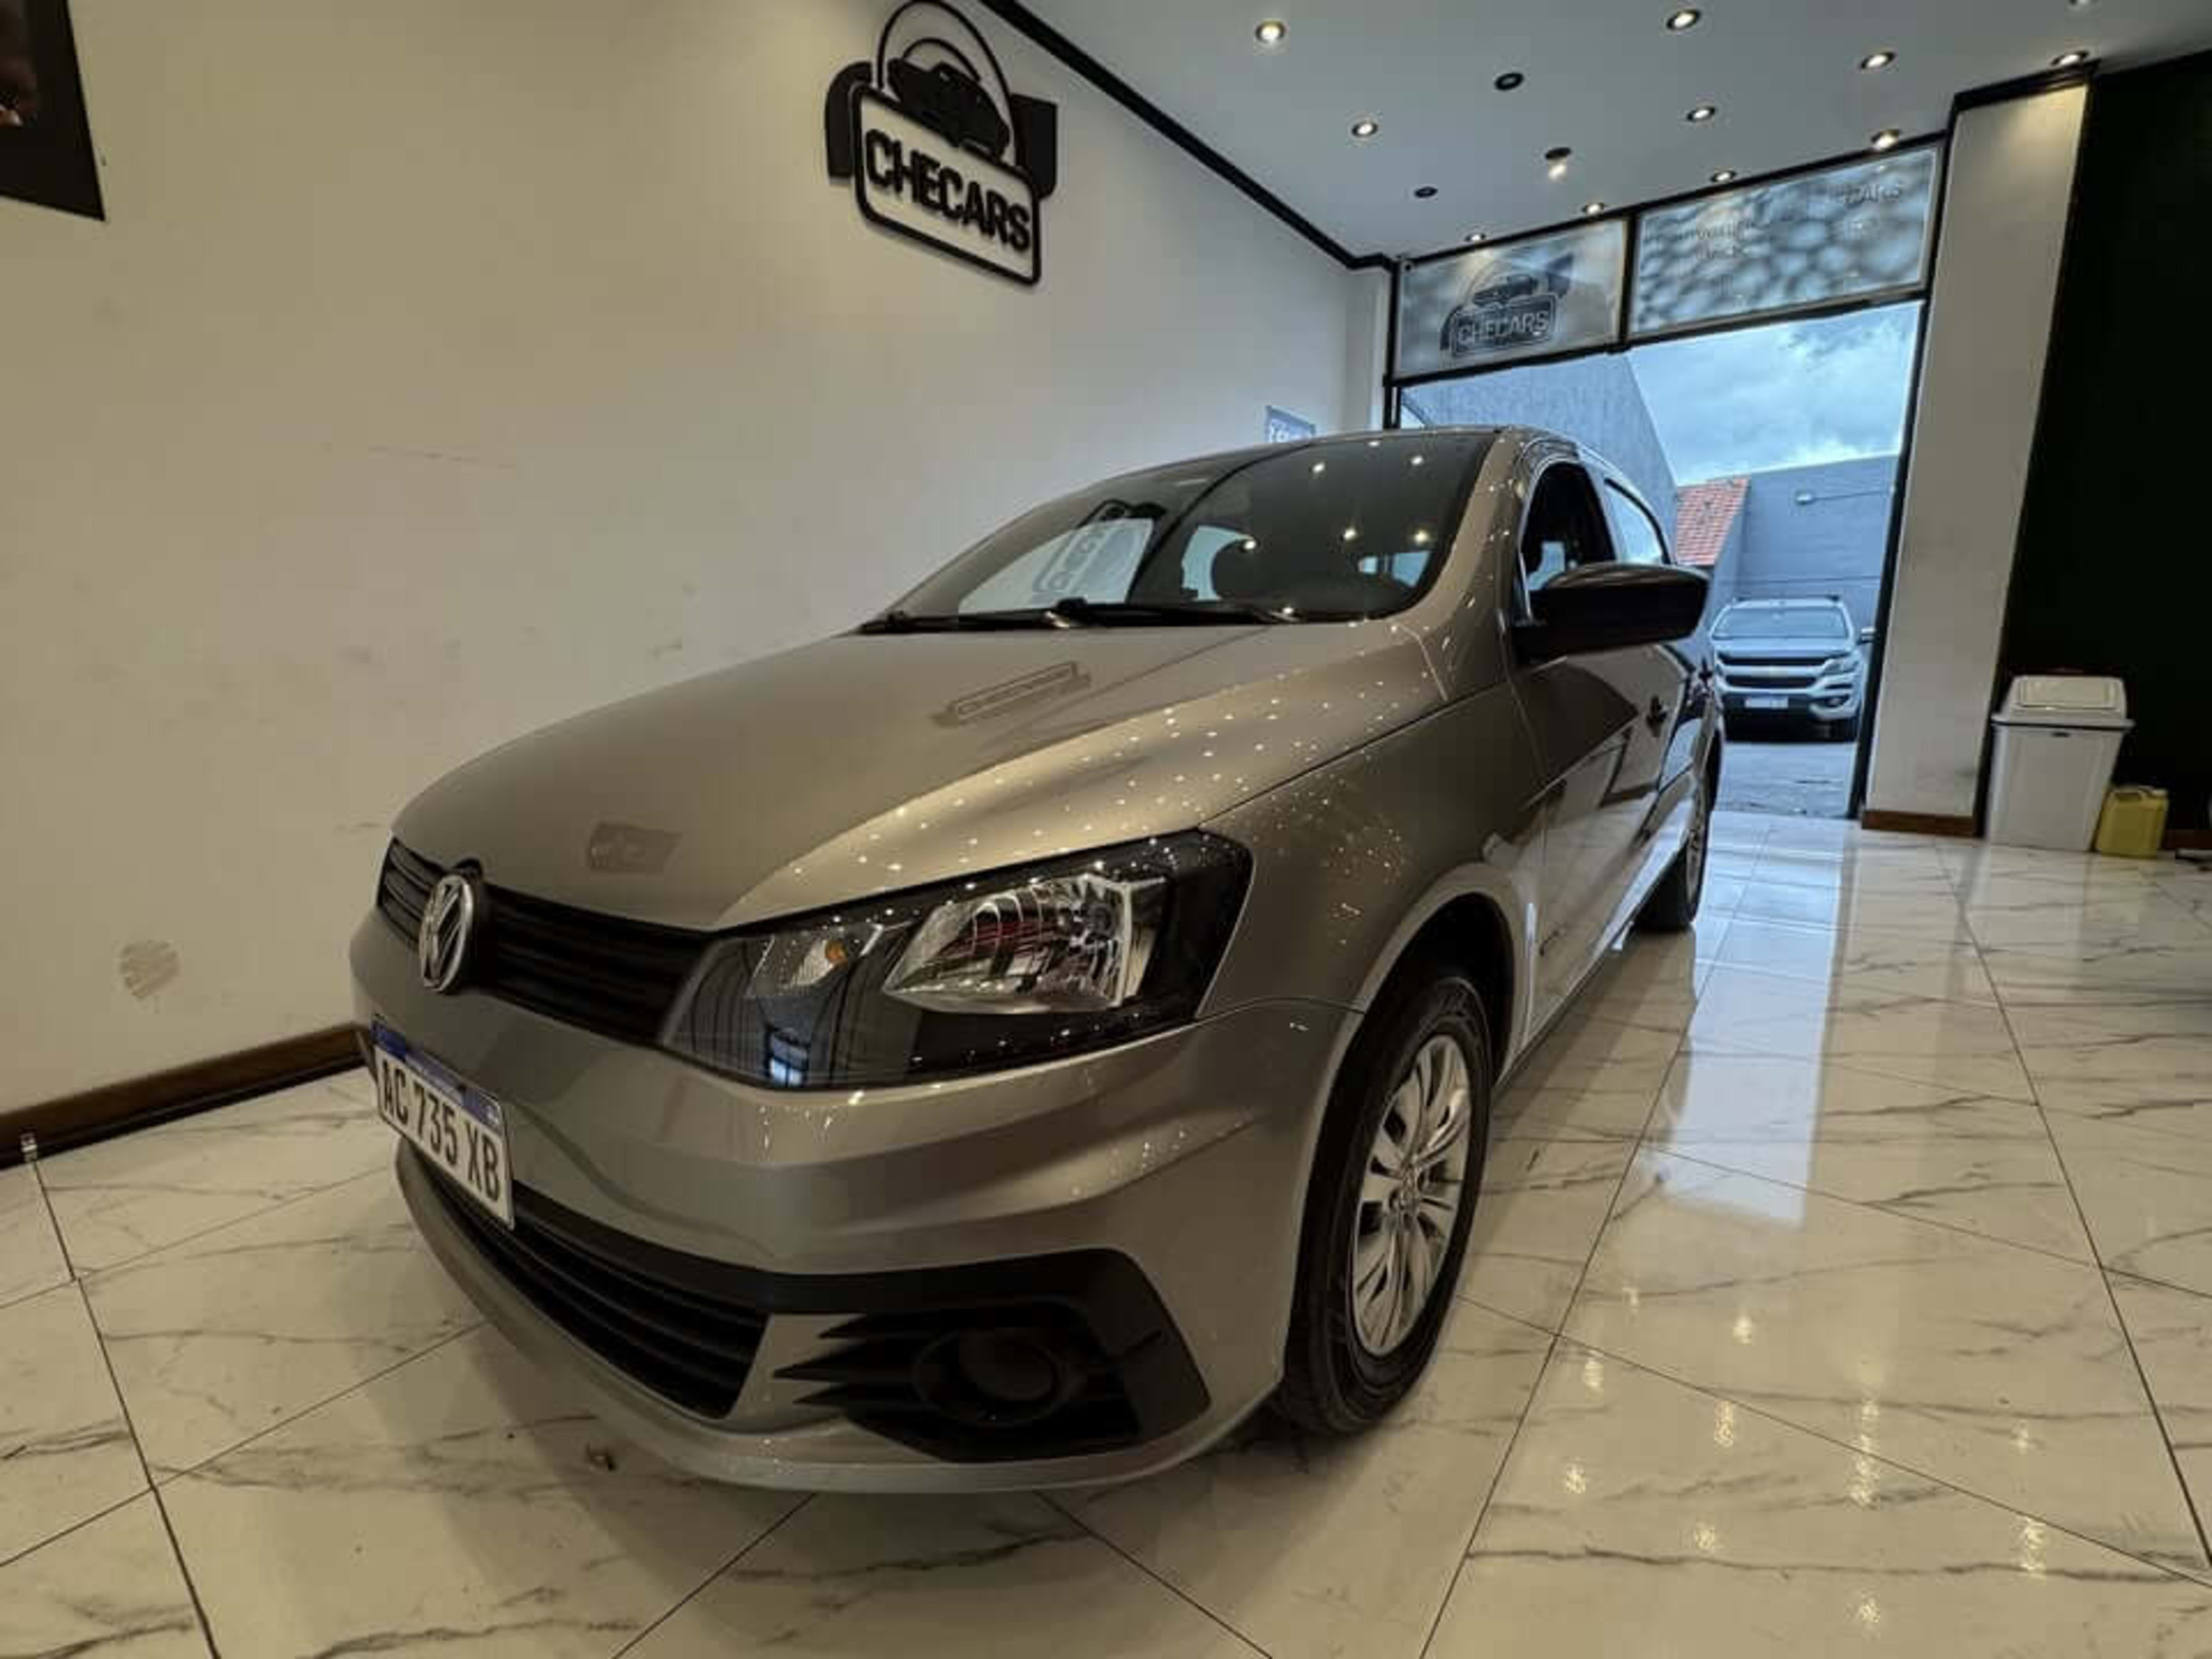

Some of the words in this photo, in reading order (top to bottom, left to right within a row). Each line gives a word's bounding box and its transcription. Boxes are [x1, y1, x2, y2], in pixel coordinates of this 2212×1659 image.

[865, 128, 1031, 252] CHECARS
[1457, 311, 1548, 345] CHECARS
[382, 1059, 408, 1126] AC
[413, 1081, 458, 1166] 735
[465, 1120, 499, 1202] XB
